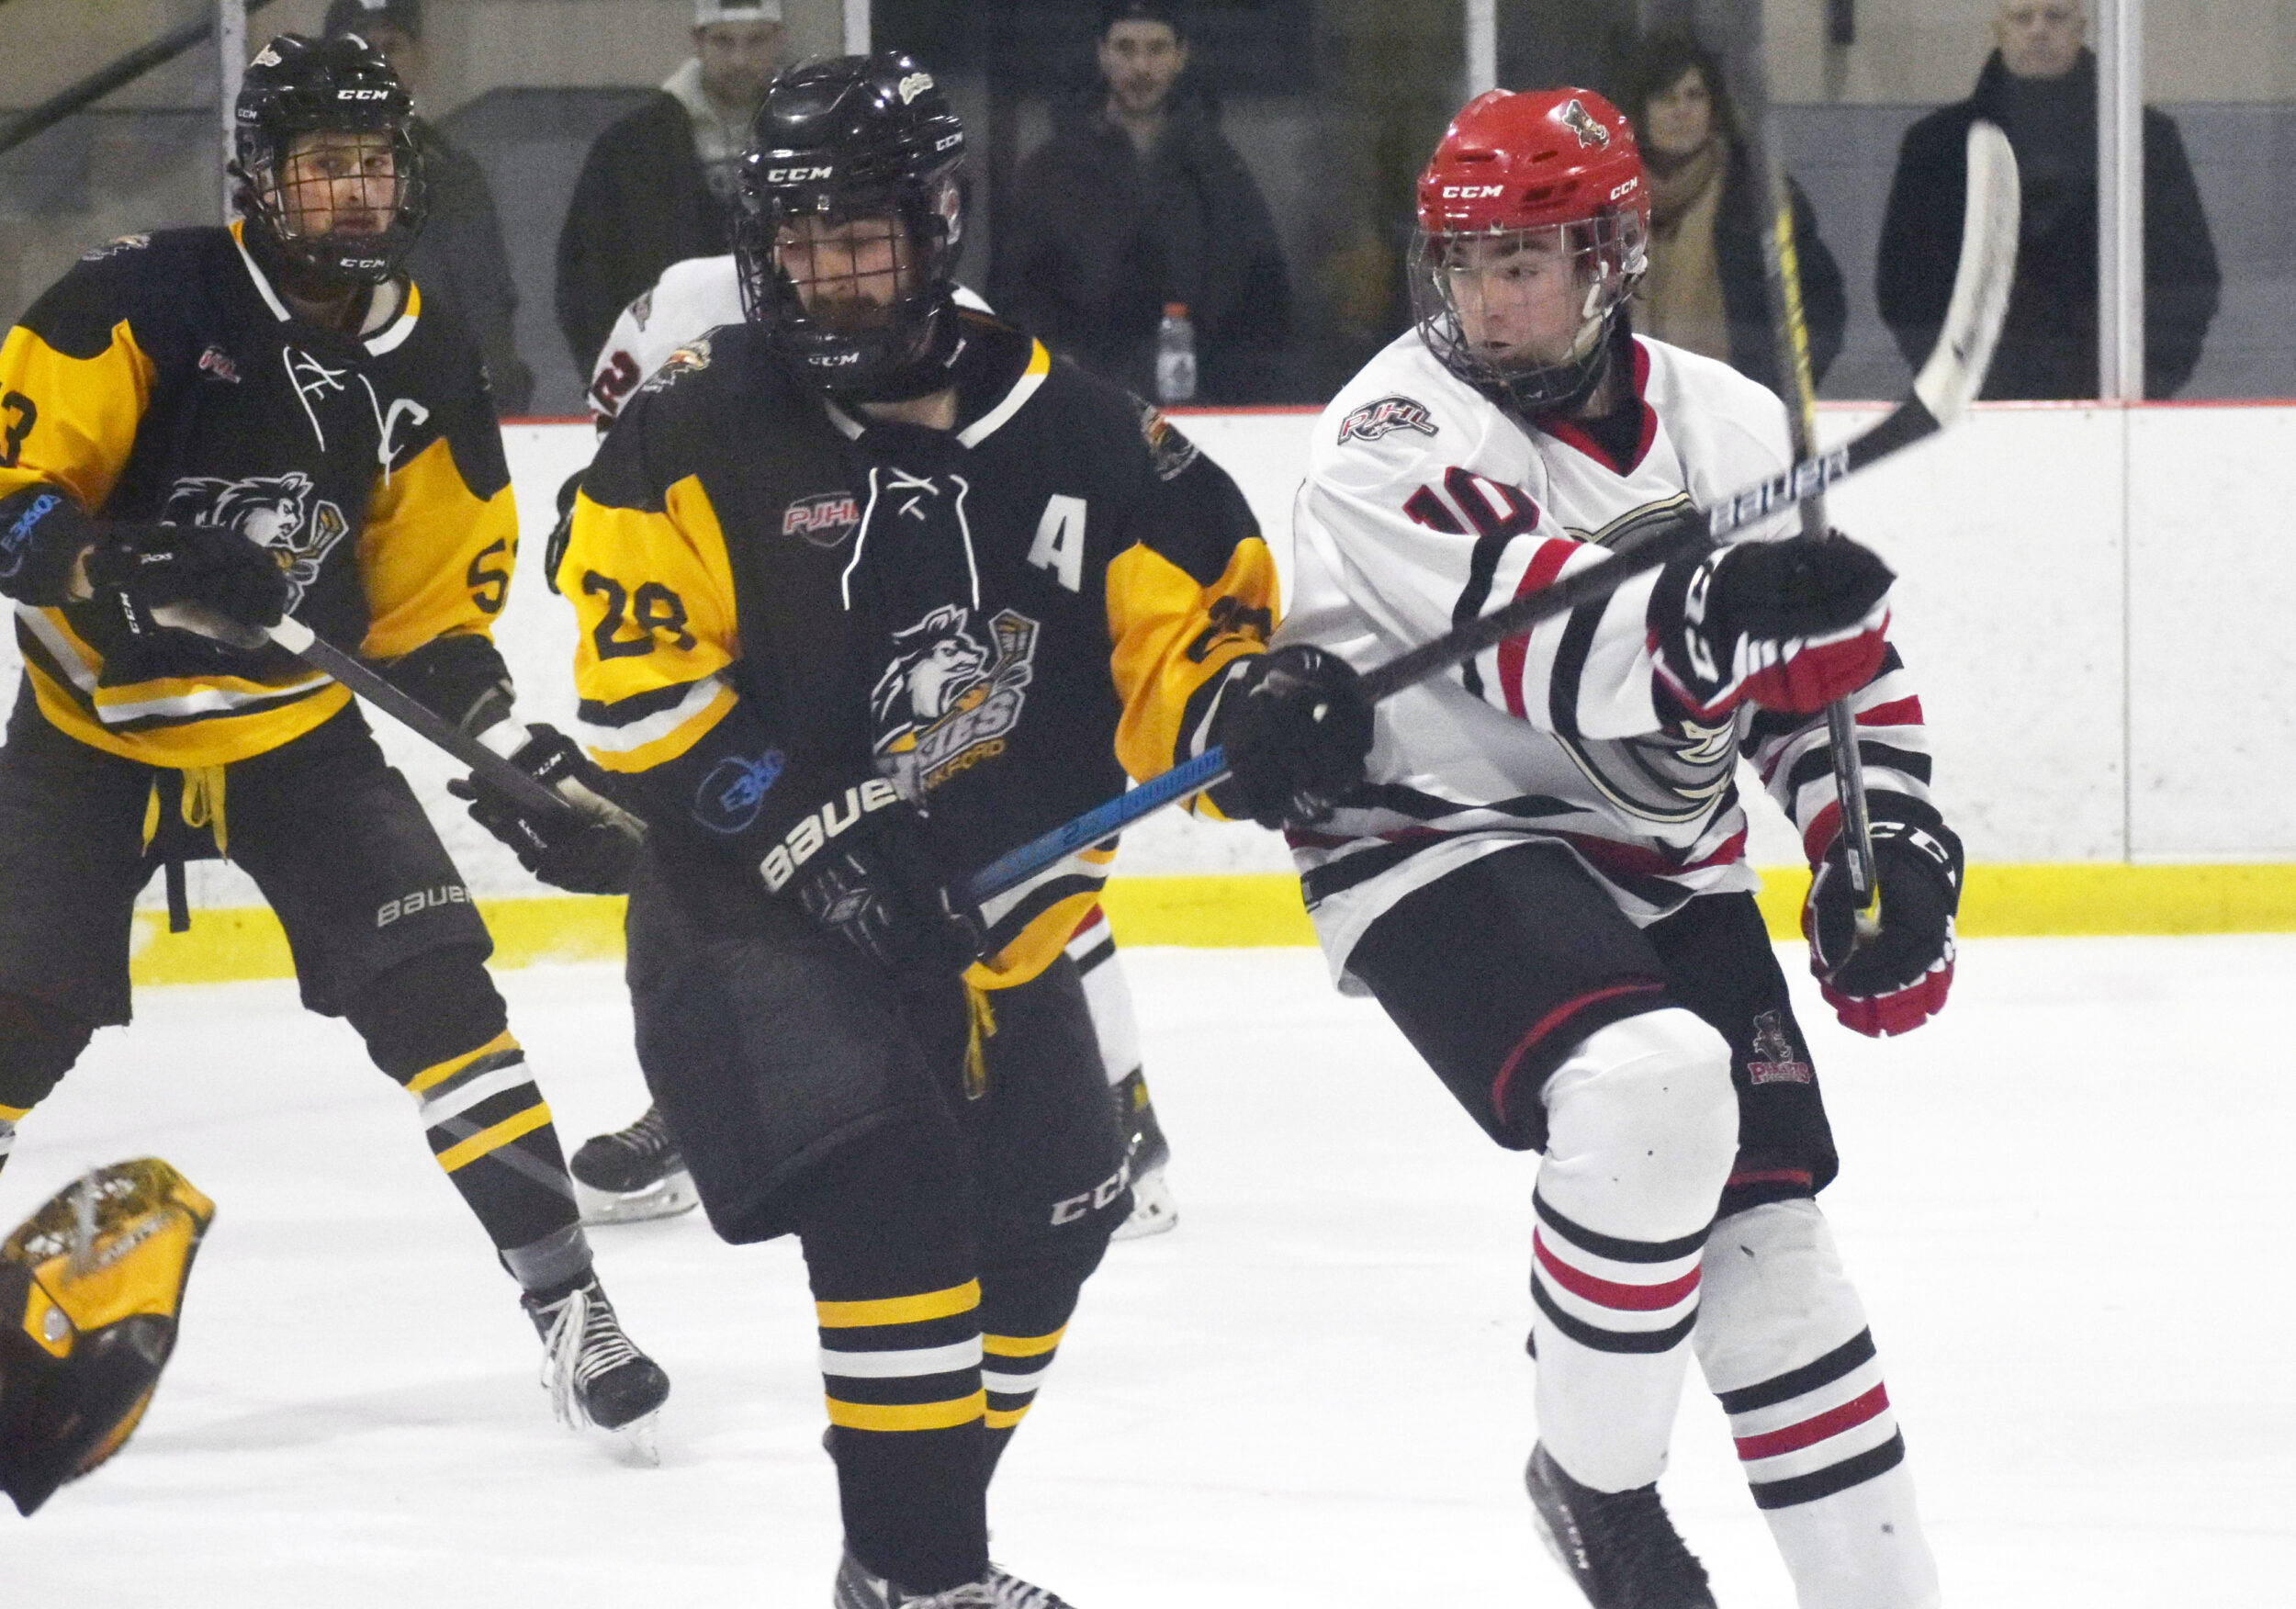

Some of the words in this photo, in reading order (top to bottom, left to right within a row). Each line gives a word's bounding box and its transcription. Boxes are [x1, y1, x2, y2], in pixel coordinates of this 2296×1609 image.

[337, 90, 388, 100] CCM
[238, 107, 257, 119] CCM
[935, 131, 963, 152] CCM
[767, 166, 834, 182] CCM
[1443, 185, 1504, 198] CCM
[1610, 176, 1638, 200] CCM
[340, 257, 386, 268] CCM
[1337, 402, 1439, 445] PJHL
[1401, 466, 1540, 535] 10
[1027, 493, 1087, 593] A
[467, 537, 519, 614] 5
[119, 591, 141, 634] CCM
